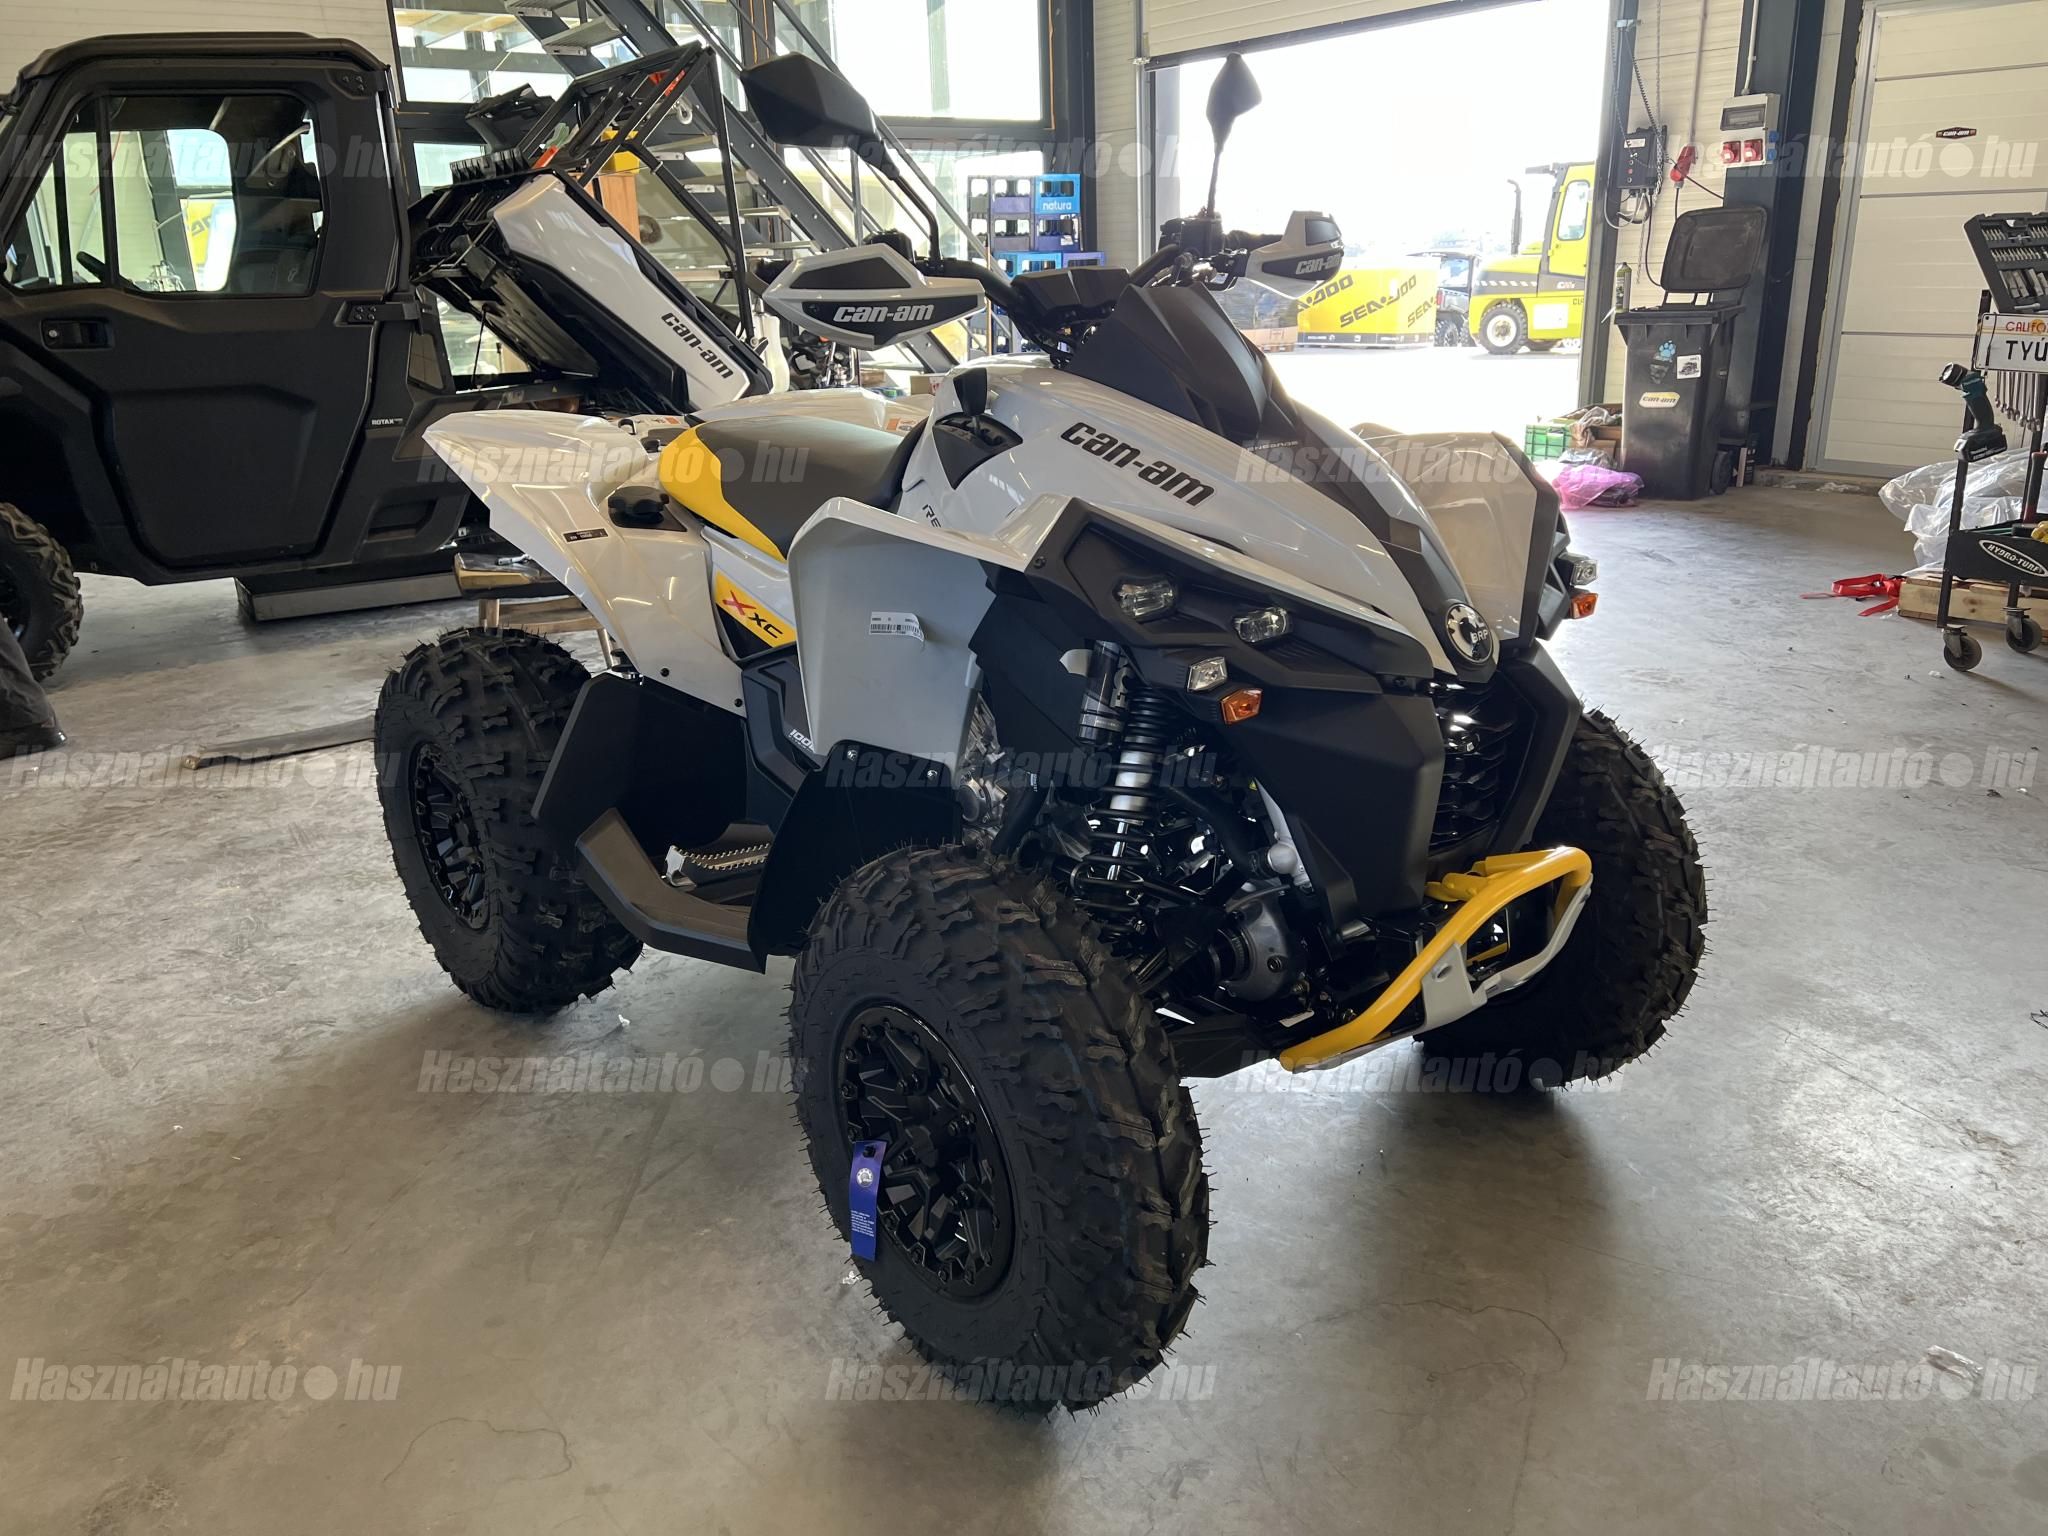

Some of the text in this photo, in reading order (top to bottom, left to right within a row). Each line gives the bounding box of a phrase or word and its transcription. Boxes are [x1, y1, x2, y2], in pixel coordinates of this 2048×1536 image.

[1042, 201, 1072, 210] natura
[833, 304, 935, 323] can-am
[661, 312, 734, 379] can-am
[371, 418, 395, 426] ROTAX
[1247, 441, 1299, 452] ENEGADE
[1060, 422, 1215, 507] can-am
[1987, 543, 2041, 572] HYDRO-TURF
[1470, 629, 1488, 643] BRP
